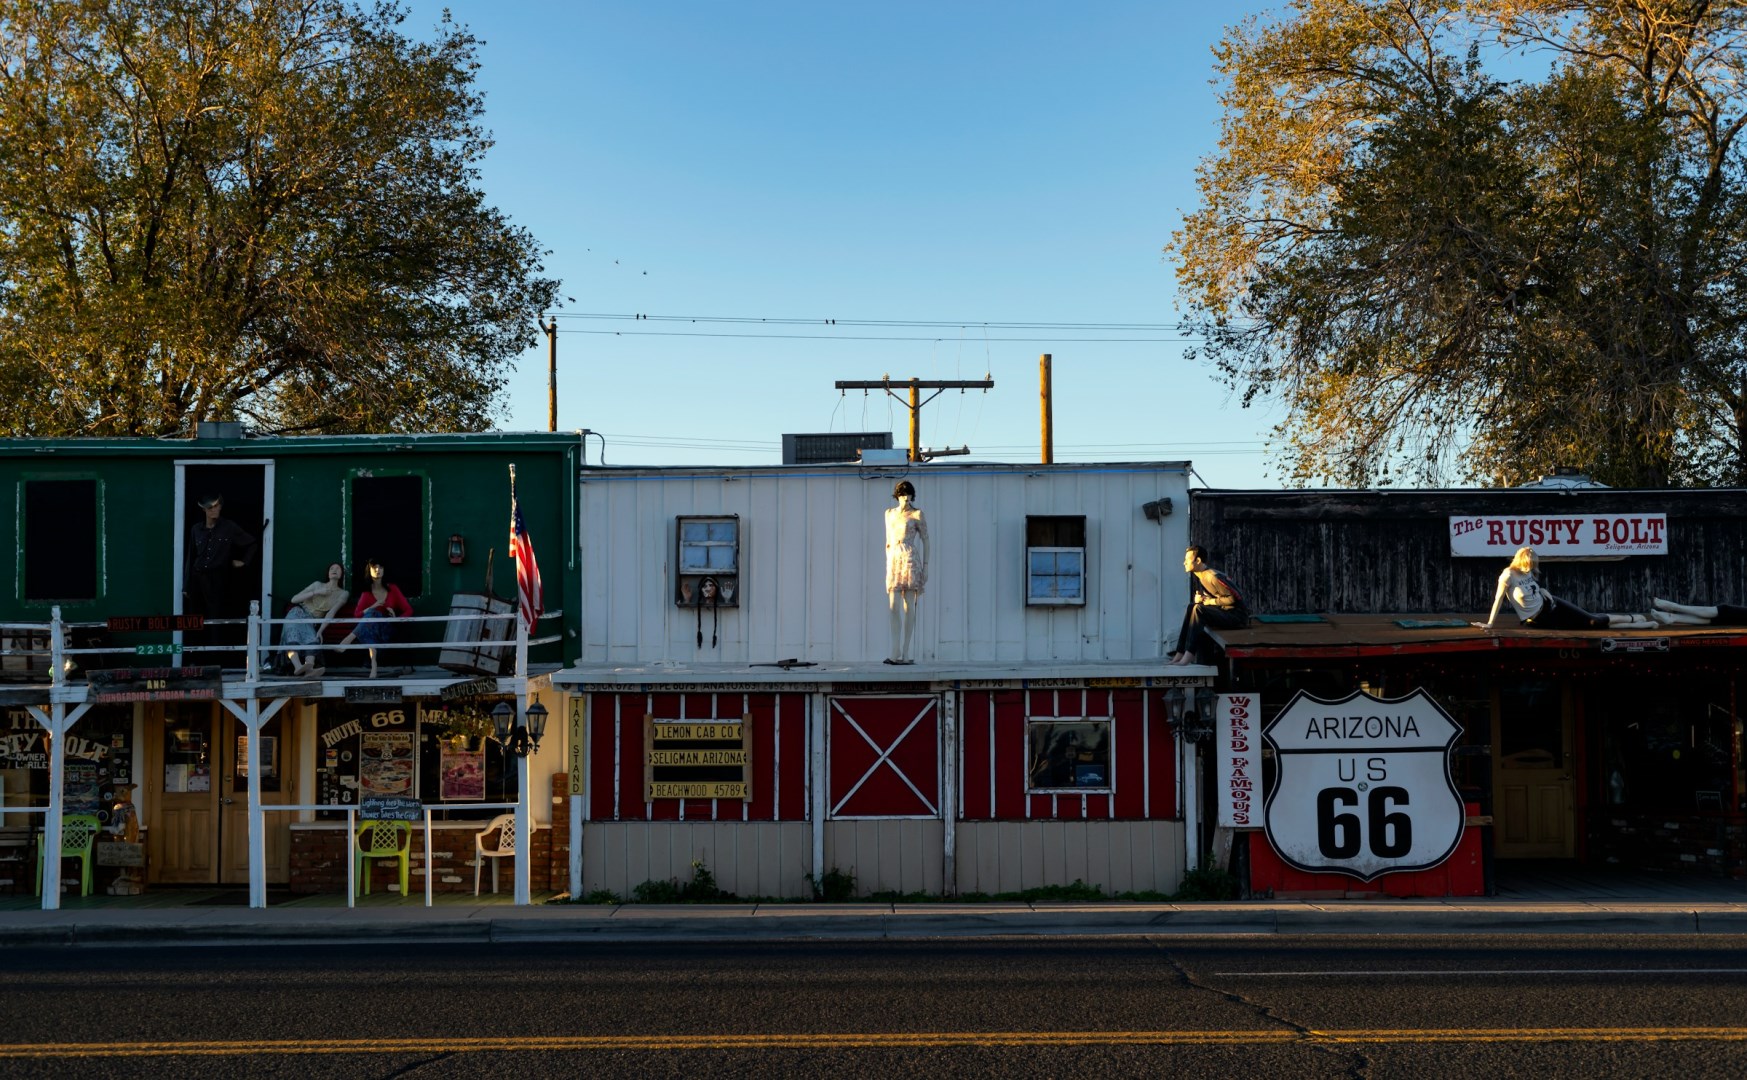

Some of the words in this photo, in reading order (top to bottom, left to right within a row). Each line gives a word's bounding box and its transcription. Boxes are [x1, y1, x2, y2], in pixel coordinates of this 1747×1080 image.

[1453, 518, 1484, 537] The
[1486, 519, 1584, 546] RUSTY
[1593, 518, 1664, 544] BOLT
[113, 616, 141, 631] RUSTY
[148, 616, 170, 630] BOLT
[177, 616, 199, 629] BLVD
[138, 644, 183, 655] 22345
[1558, 648, 1581, 660] 66
[146, 680, 166, 690] AND
[321, 718, 363, 749] ROUTE
[371, 709, 406, 728] 66
[572, 699, 580, 737] TAXI
[1228, 696, 1251, 753] WORLD
[1305, 715, 1420, 740] ARIZONA
[662, 725, 691, 738] LEMON
[697, 725, 716, 738] CAB
[721, 725, 734, 738] CO
[16, 753, 46, 762] OWNER
[65, 736, 109, 764] OLT
[702, 752, 744, 764] ARIZONA
[572, 745, 580, 793] STAND
[656, 784, 707, 797] BEACHWOOD
[714, 784, 741, 797] 45789
[1229, 757, 1253, 825] FAMOUS
[1317, 786, 1412, 860] 66
